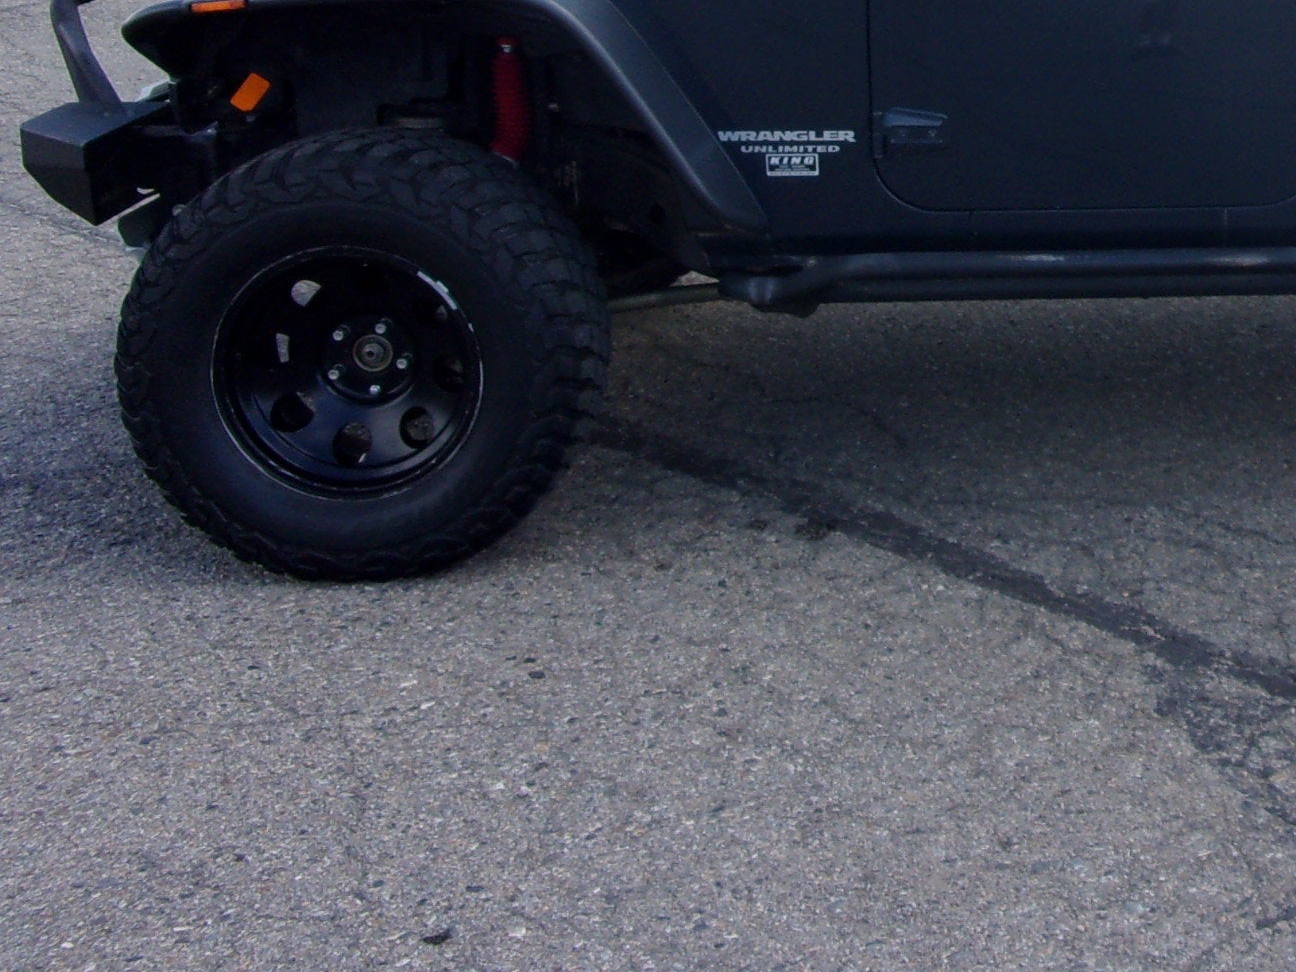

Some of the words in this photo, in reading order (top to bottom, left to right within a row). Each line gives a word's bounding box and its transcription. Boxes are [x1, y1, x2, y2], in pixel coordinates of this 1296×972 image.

[717, 130, 856, 143] WRANGLER
[740, 145, 841, 154] UNLIMITED
[769, 156, 815, 166] KING
